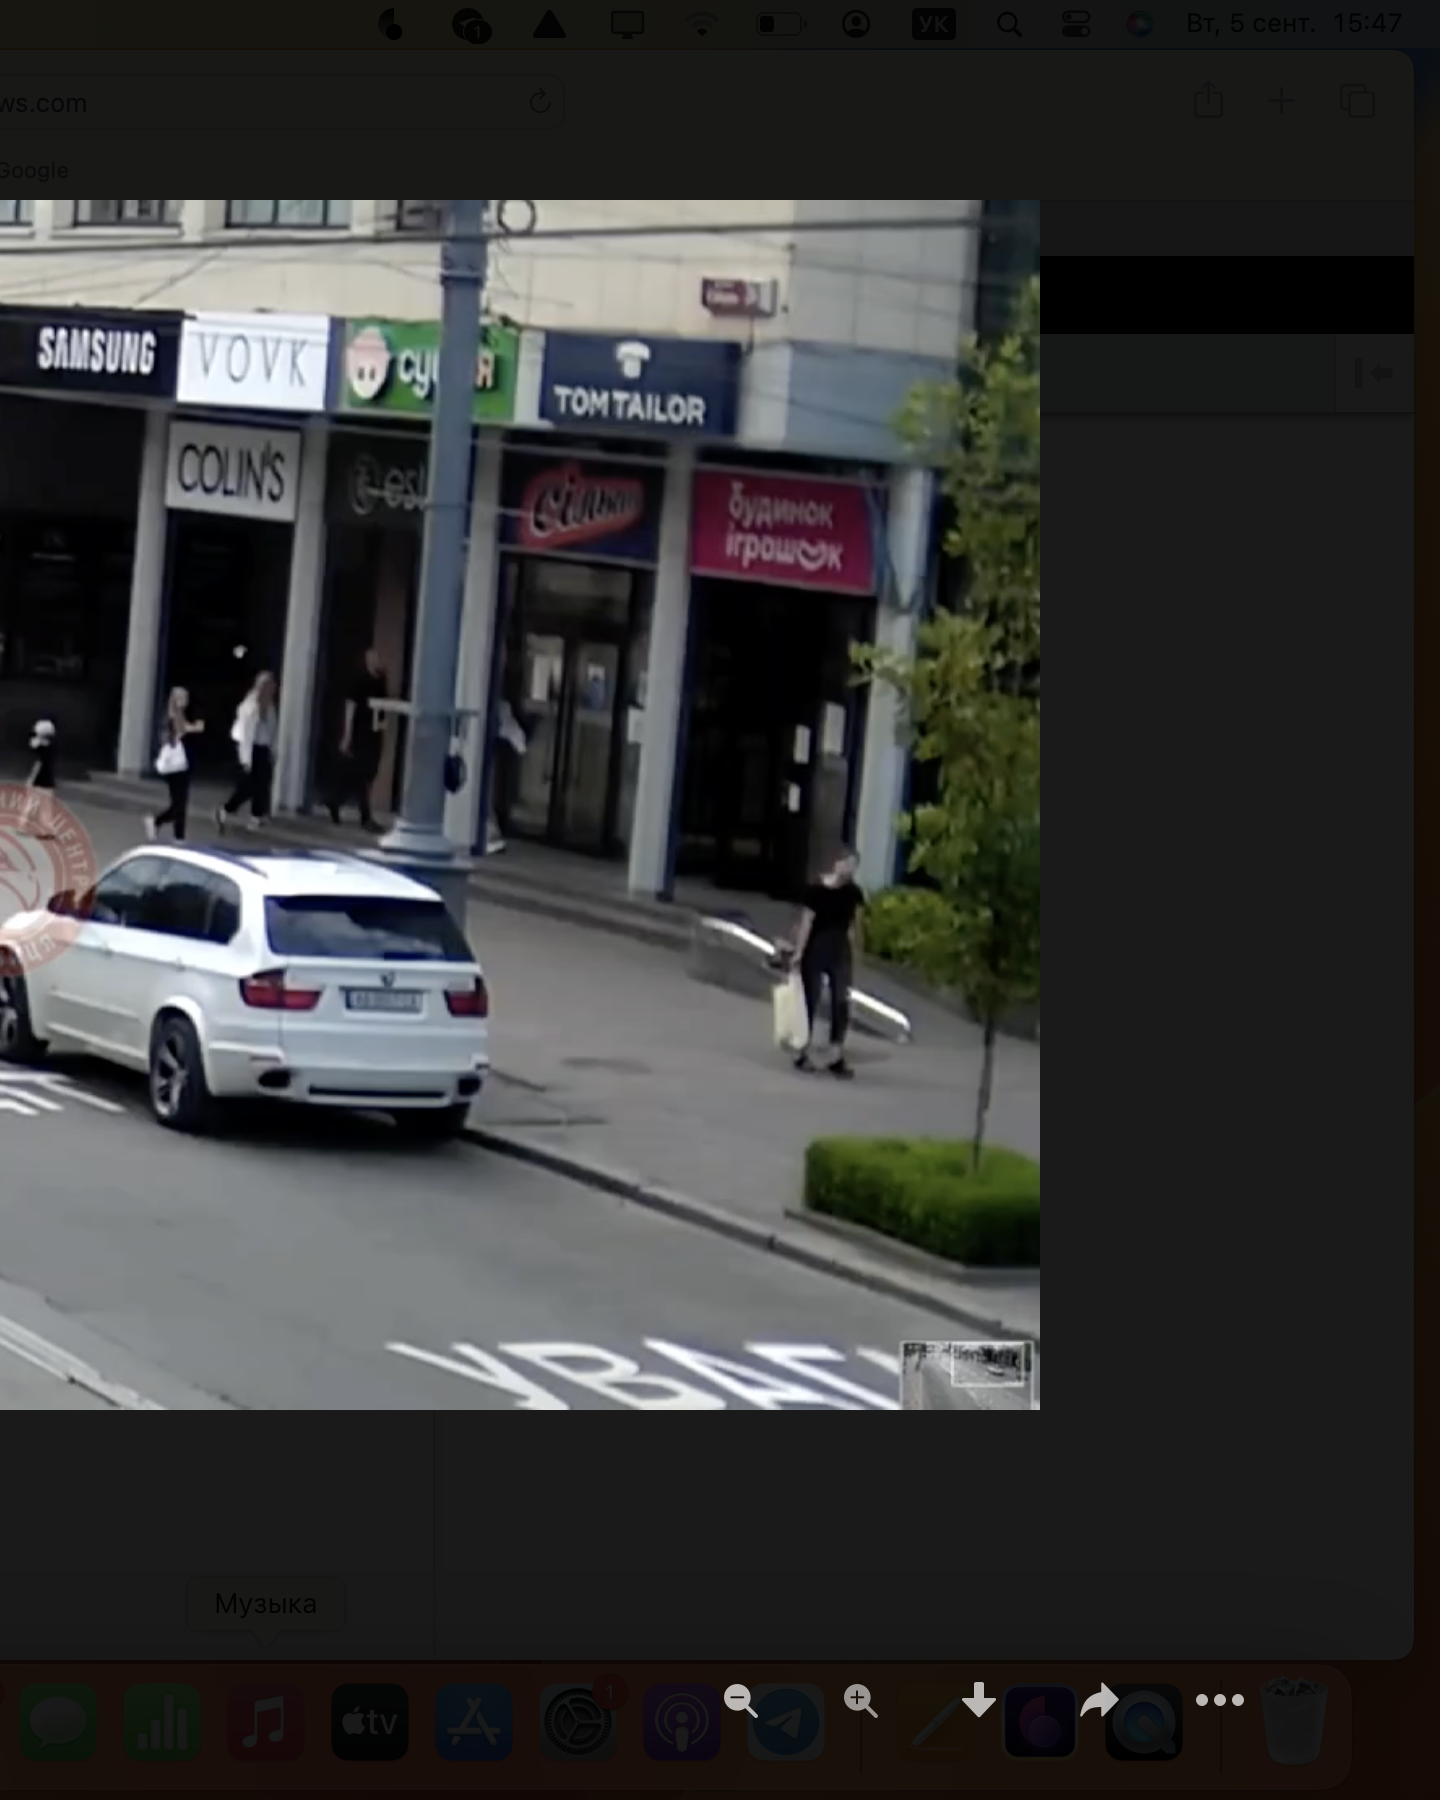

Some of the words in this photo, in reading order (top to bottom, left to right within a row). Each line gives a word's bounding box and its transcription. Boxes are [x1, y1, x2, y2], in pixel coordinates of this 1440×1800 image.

[918, 15, 949, 33] УК
[1188, 13, 1219, 37] Вт,
[1231, 13, 1244, 33] 5
[1252, 17, 1315, 33] сент.
[1335, 13, 1402, 34] 15:47
[39, 326, 157, 376] SAMSUNG
[201, 333, 310, 388] VOVK
[398, 347, 496, 401] суя
[554, 384, 610, 419] TOM
[611, 390, 706, 425] TAILOR
[178, 440, 286, 502] COLIN'S
[729, 480, 834, 530] будинок
[386, 1337, 900, 1410] УВАГ
[215, 1592, 317, 1619] Музыка
[605, 1684, 614, 1701] 1
